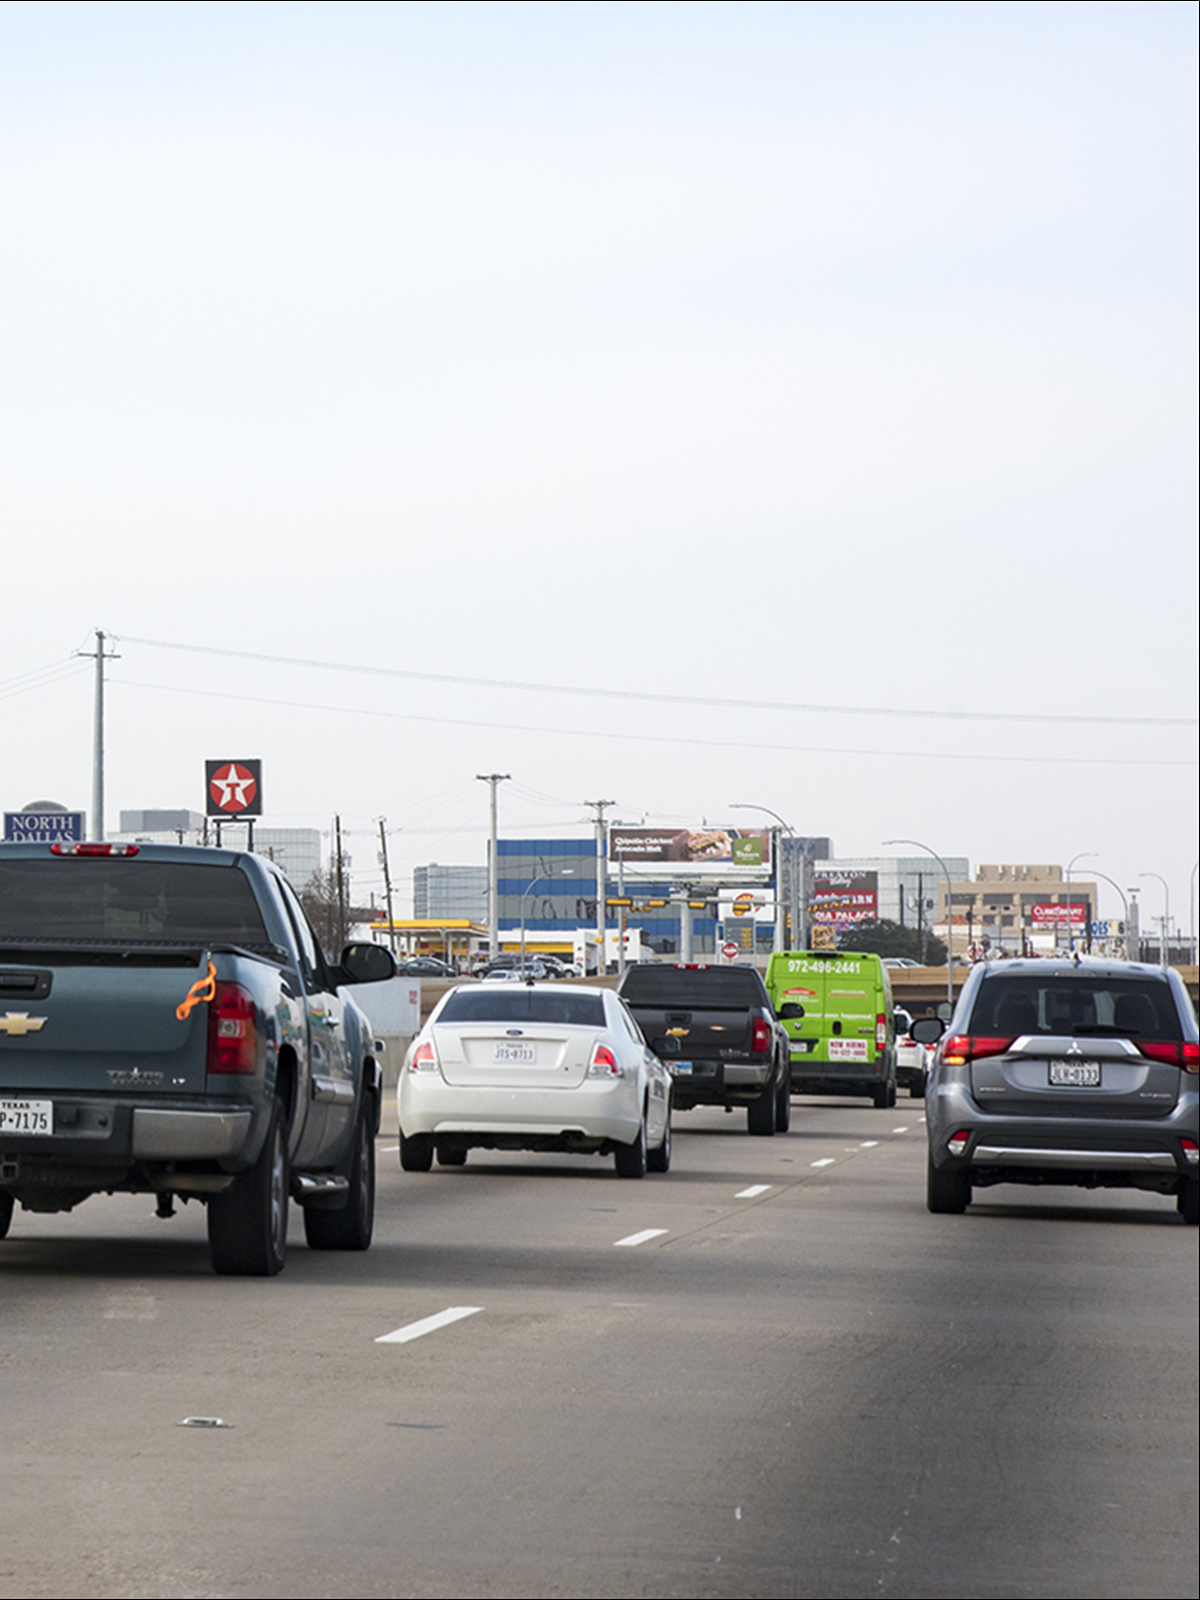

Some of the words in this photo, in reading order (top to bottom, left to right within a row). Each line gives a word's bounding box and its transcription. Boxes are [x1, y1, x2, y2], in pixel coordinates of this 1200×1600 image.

[12, 816, 73, 830] NORTH
[12, 831, 75, 842] DALLAS
[788, 960, 860, 974] 972-496-2441
